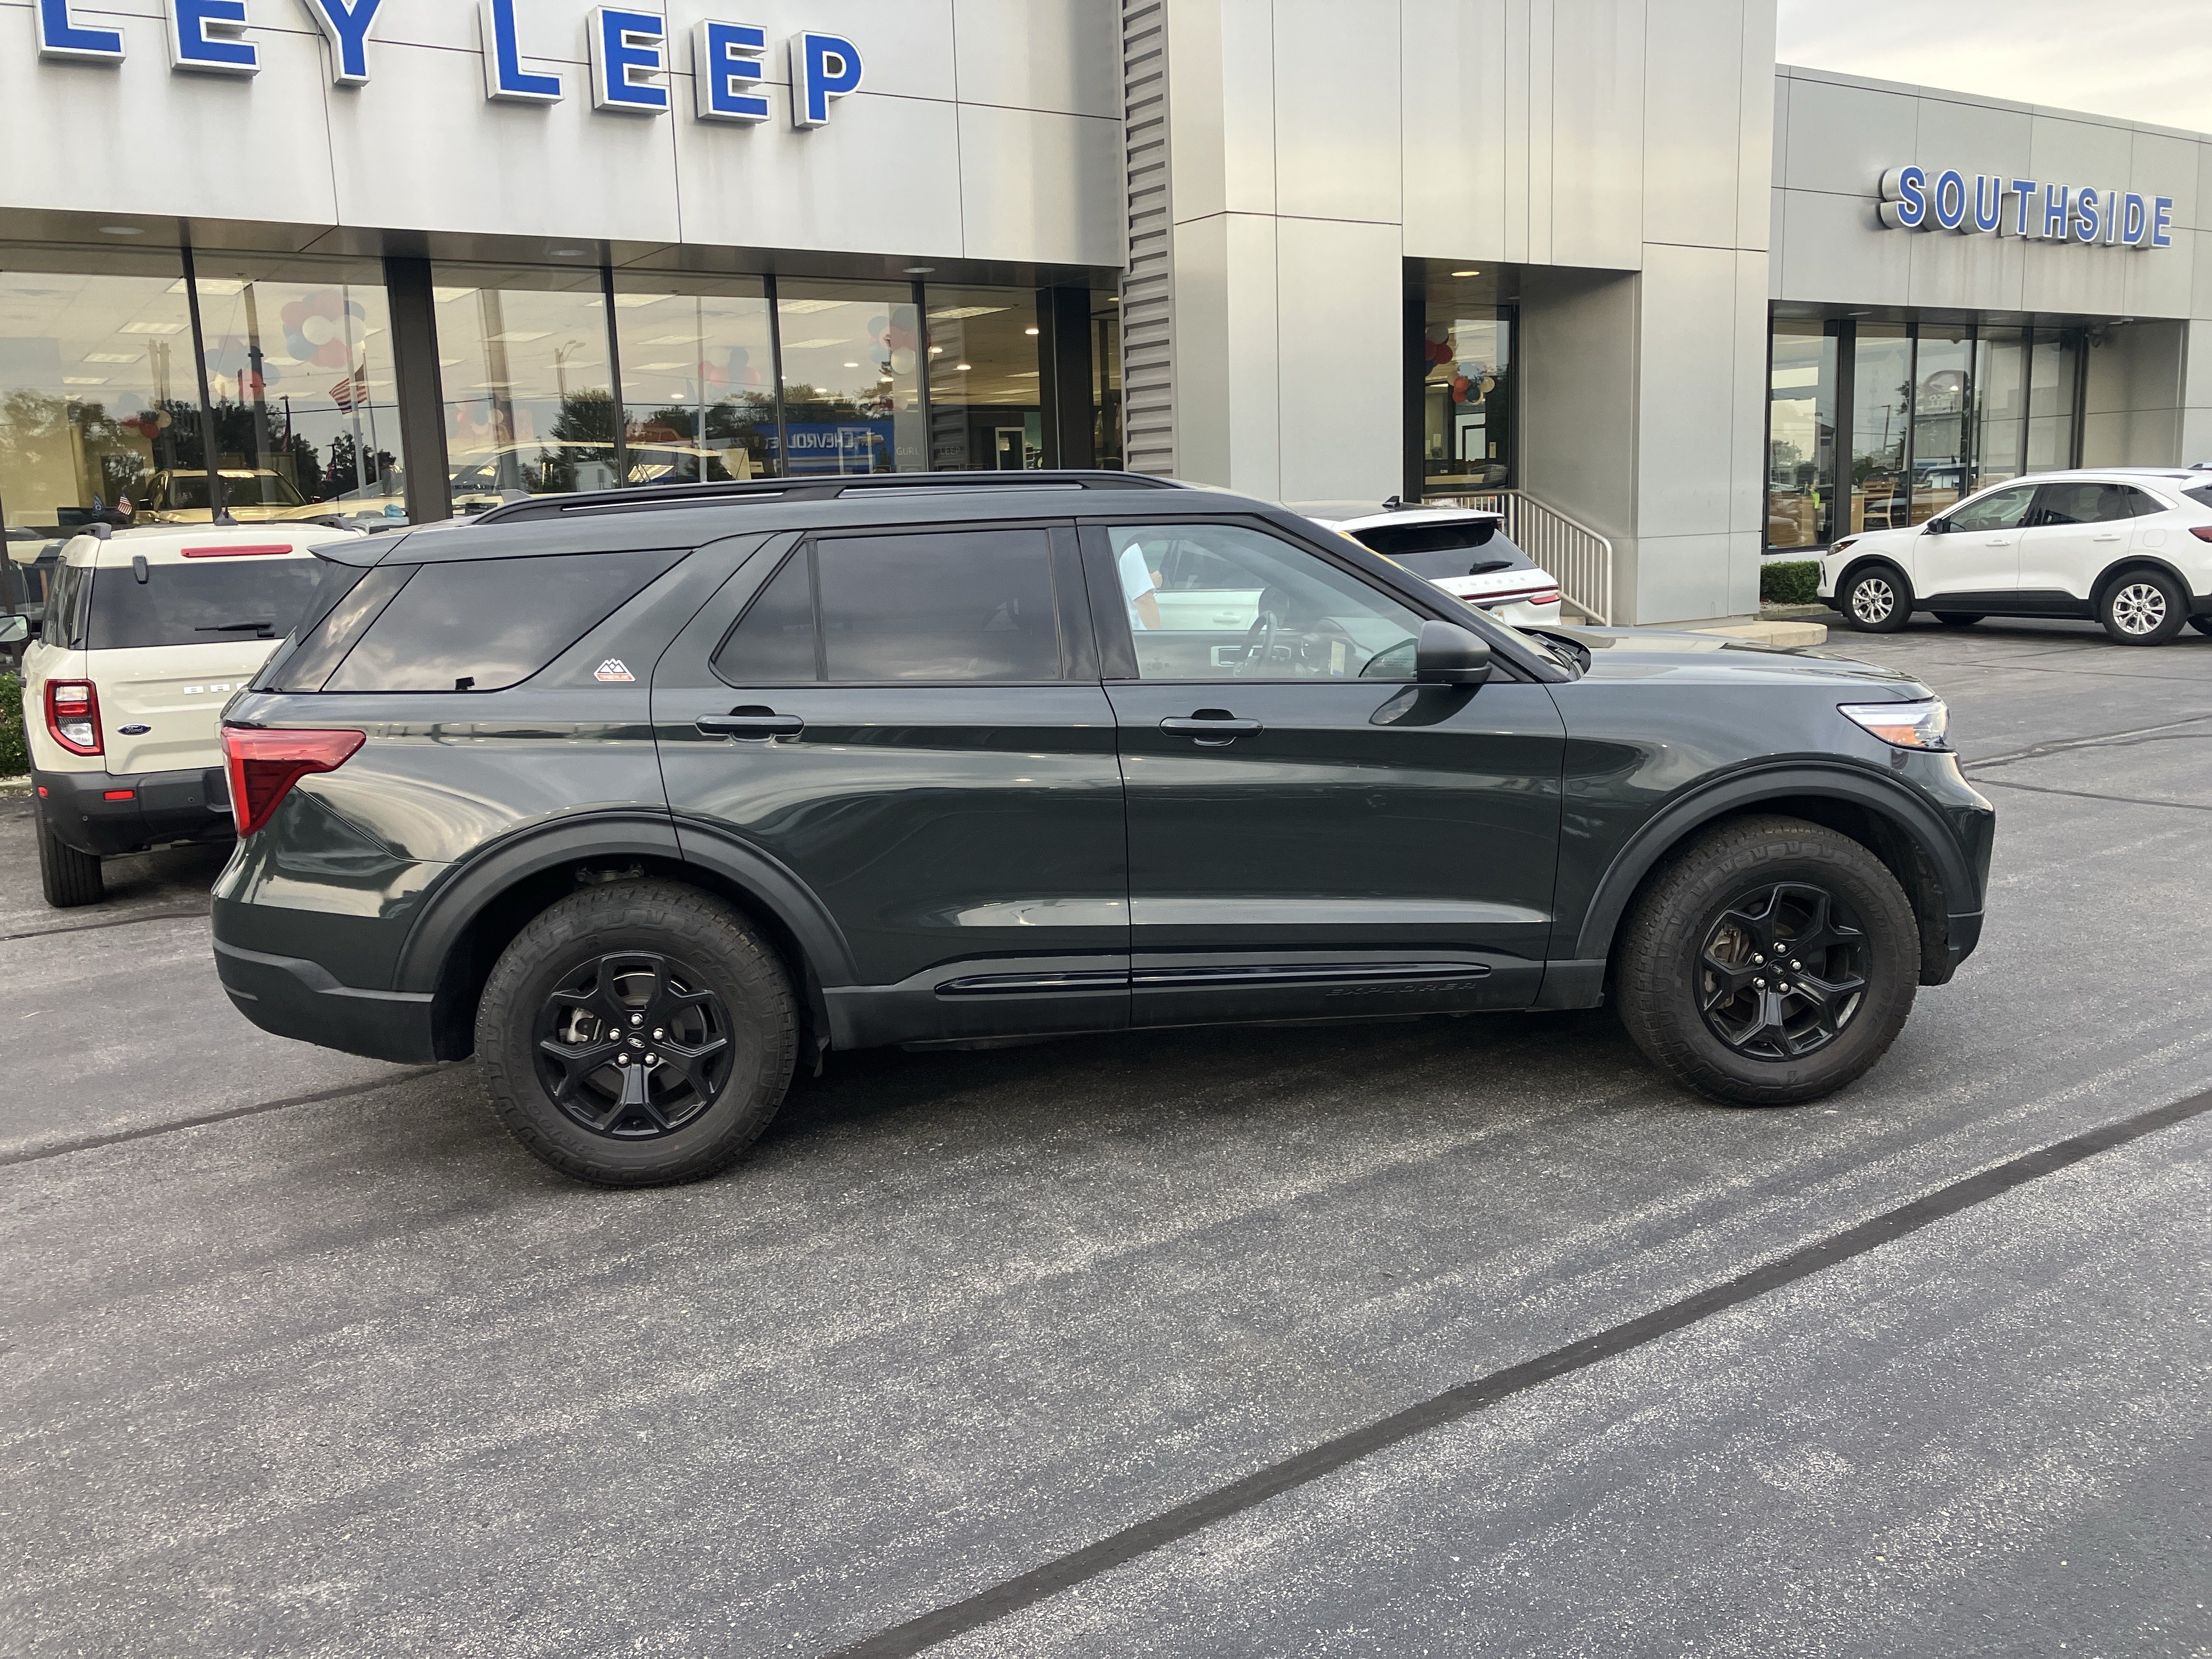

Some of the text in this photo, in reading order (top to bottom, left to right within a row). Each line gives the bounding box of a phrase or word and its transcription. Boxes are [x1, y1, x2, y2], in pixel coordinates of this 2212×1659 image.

[481, 0, 865, 129] LEEP
[1887, 164, 2175, 249] SOUTHSIDE
[940, 447, 961, 455] LEEP
[1444, 576, 1526, 589] LINCOLN
[183, 682, 248, 695] BR
[1324, 981, 1477, 996] EXPLORER
